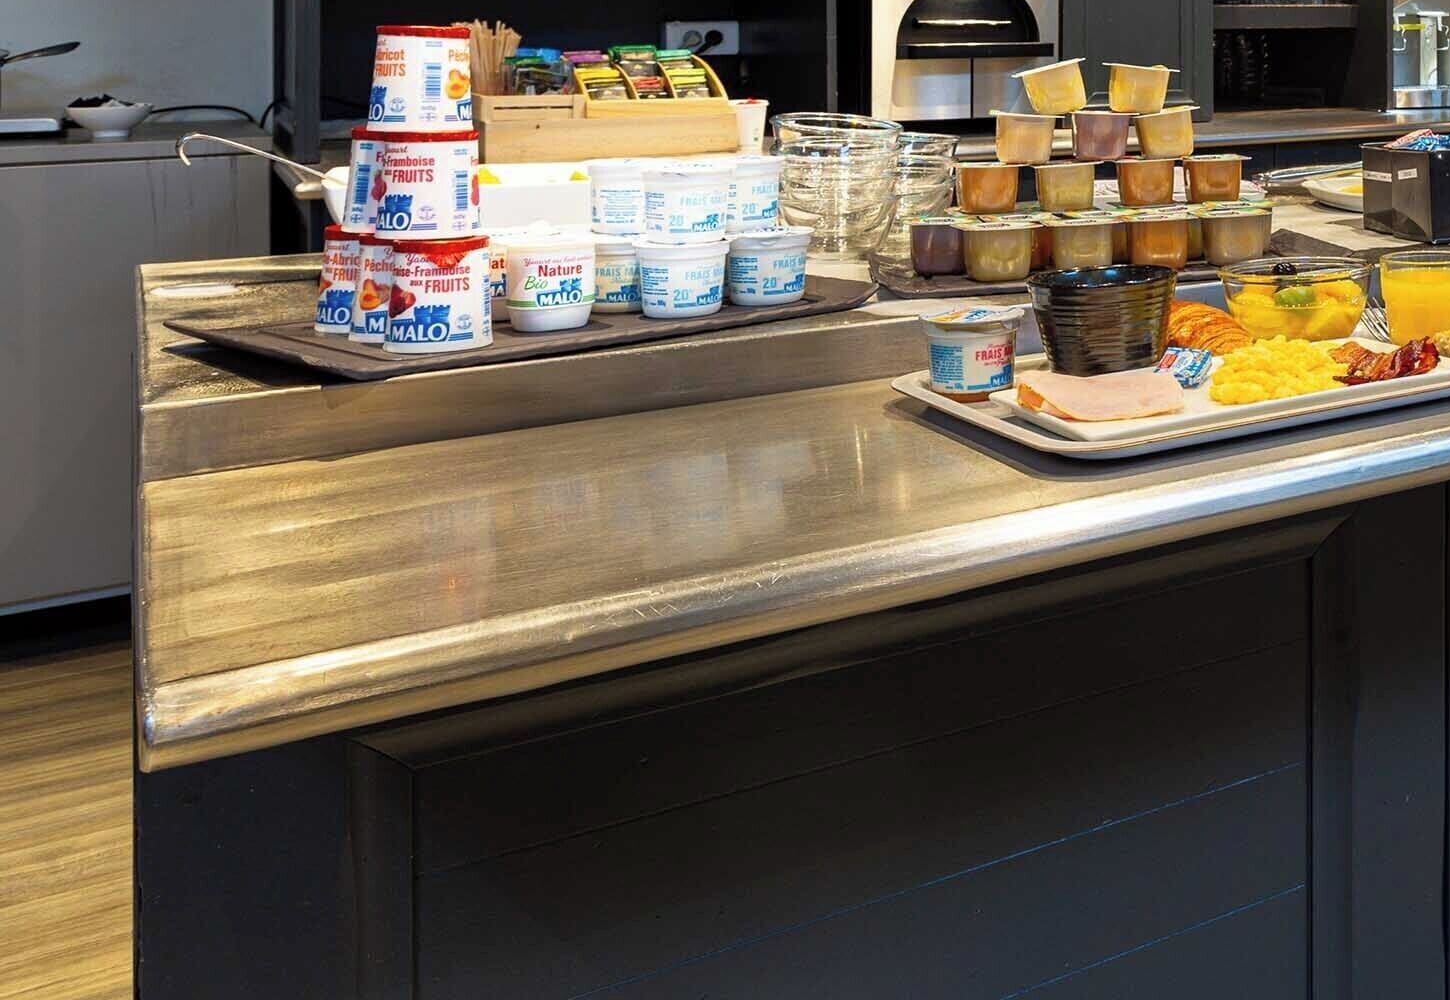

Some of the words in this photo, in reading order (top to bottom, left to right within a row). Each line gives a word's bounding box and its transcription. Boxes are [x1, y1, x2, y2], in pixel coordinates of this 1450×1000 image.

[392, 168, 434, 183] FRUITS
[538, 264, 583, 277] Nature
[424, 277, 471, 294] FRUITS
[524, 275, 549, 290] Bio
[540, 290, 581, 306] MALO
[391, 322, 448, 342] MALO
